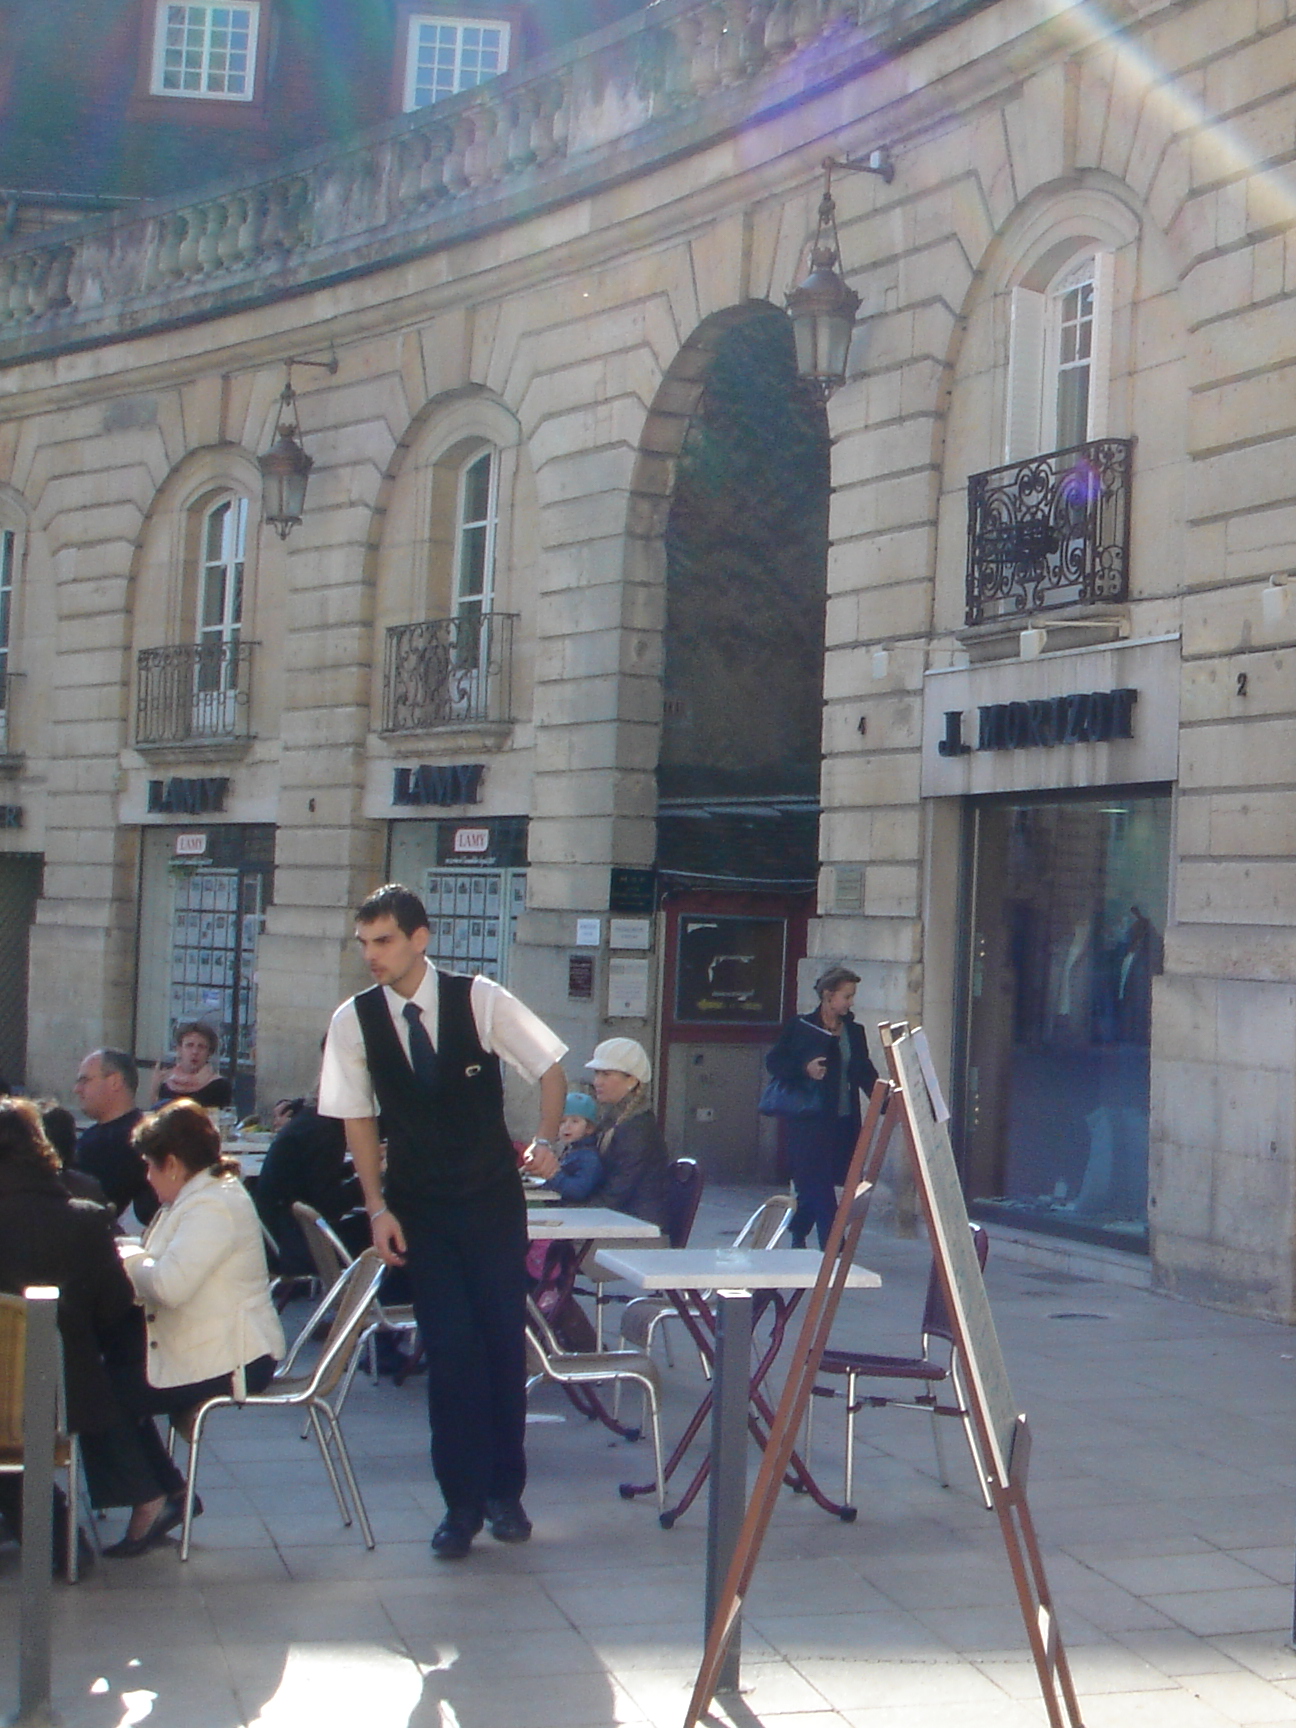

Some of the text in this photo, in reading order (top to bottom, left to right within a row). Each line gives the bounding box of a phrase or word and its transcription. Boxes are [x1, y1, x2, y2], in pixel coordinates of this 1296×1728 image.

[1236, 672, 1247, 697] 2
[977, 688, 1138, 751] MORIZOT
[147, 777, 230, 815] LAMY
[392, 764, 486, 808] LAMY
[459, 833, 486, 848] LAMY
